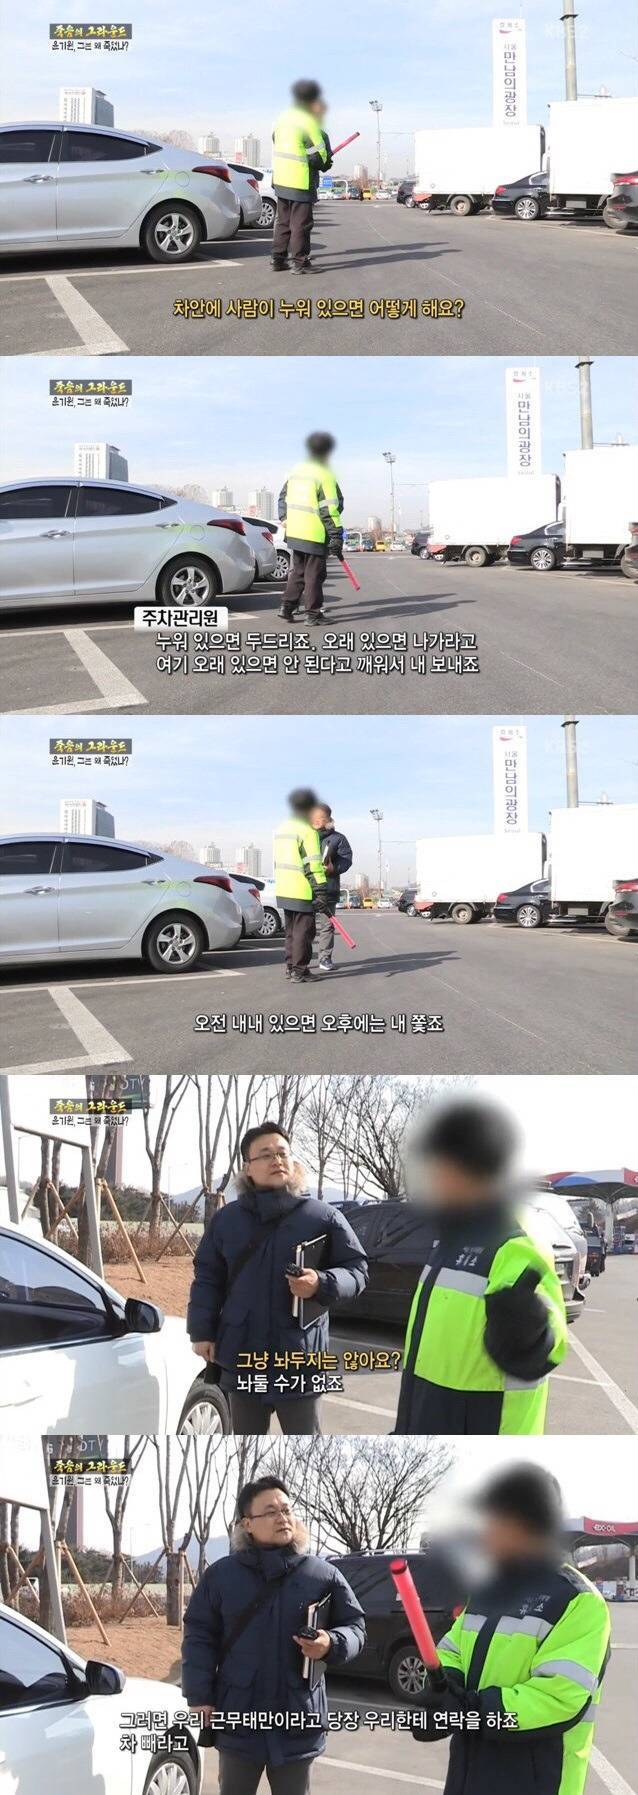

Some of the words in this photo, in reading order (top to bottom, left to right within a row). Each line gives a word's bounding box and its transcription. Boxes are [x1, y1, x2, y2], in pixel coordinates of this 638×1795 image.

[504, 51, 517, 118] 만남의광장
[518, 401, 531, 467] 만남의광장
[504, 759, 518, 825] 만남의광장
